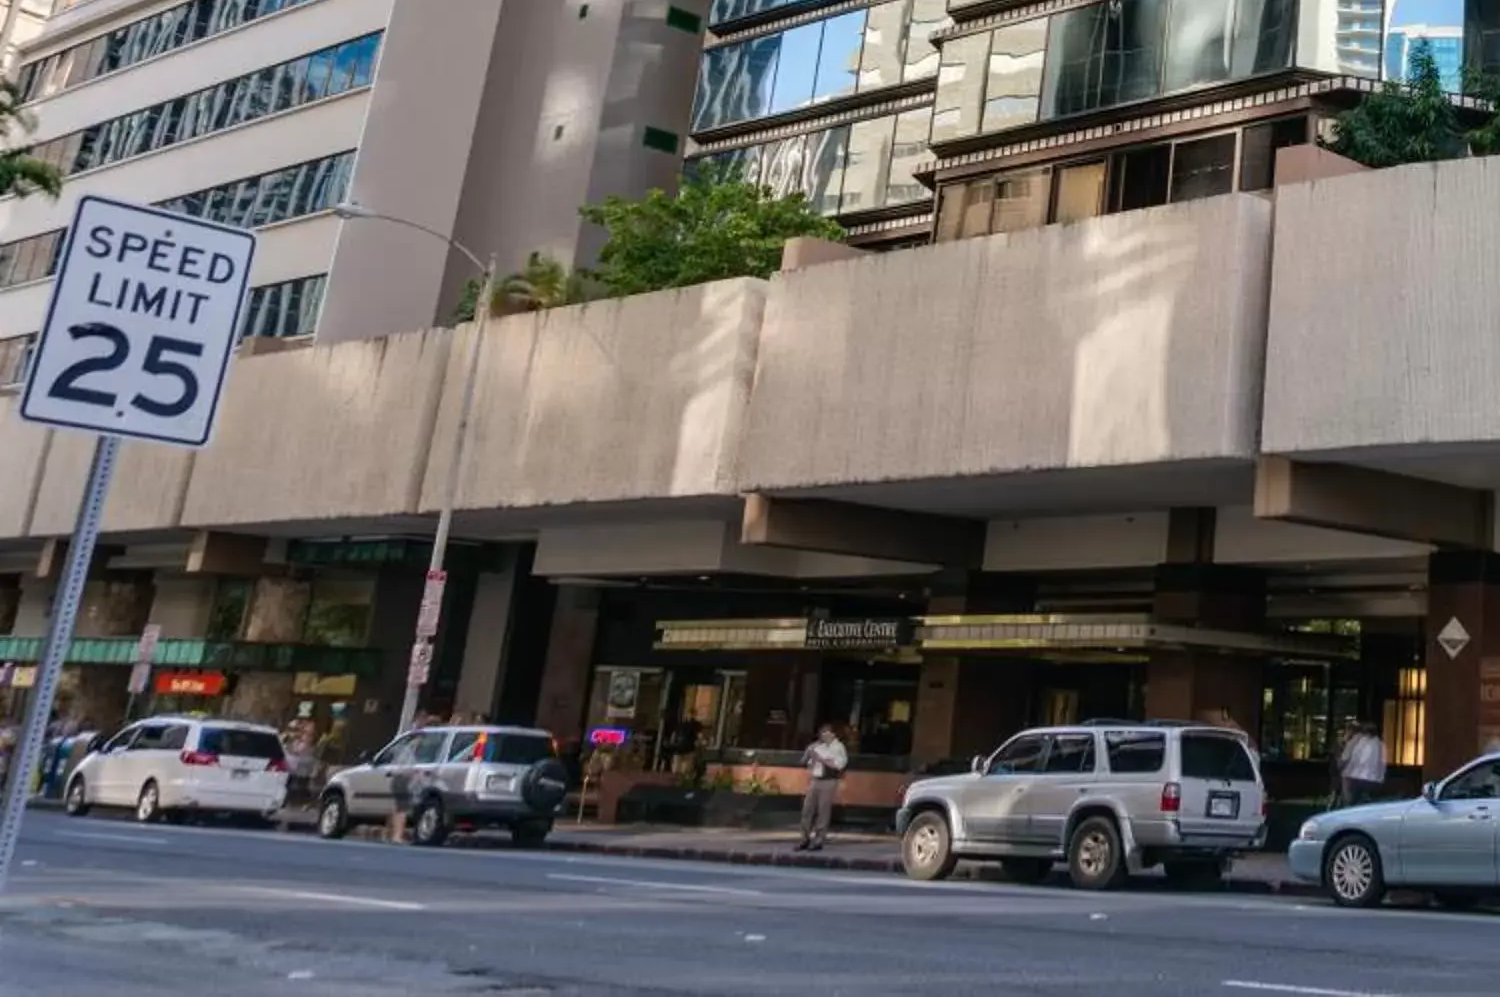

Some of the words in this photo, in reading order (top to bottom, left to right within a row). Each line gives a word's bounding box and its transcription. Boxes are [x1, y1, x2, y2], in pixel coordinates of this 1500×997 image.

[85, 226, 235, 283] SPEED
[87, 272, 210, 324] LIMIT
[47, 322, 204, 417] 25
